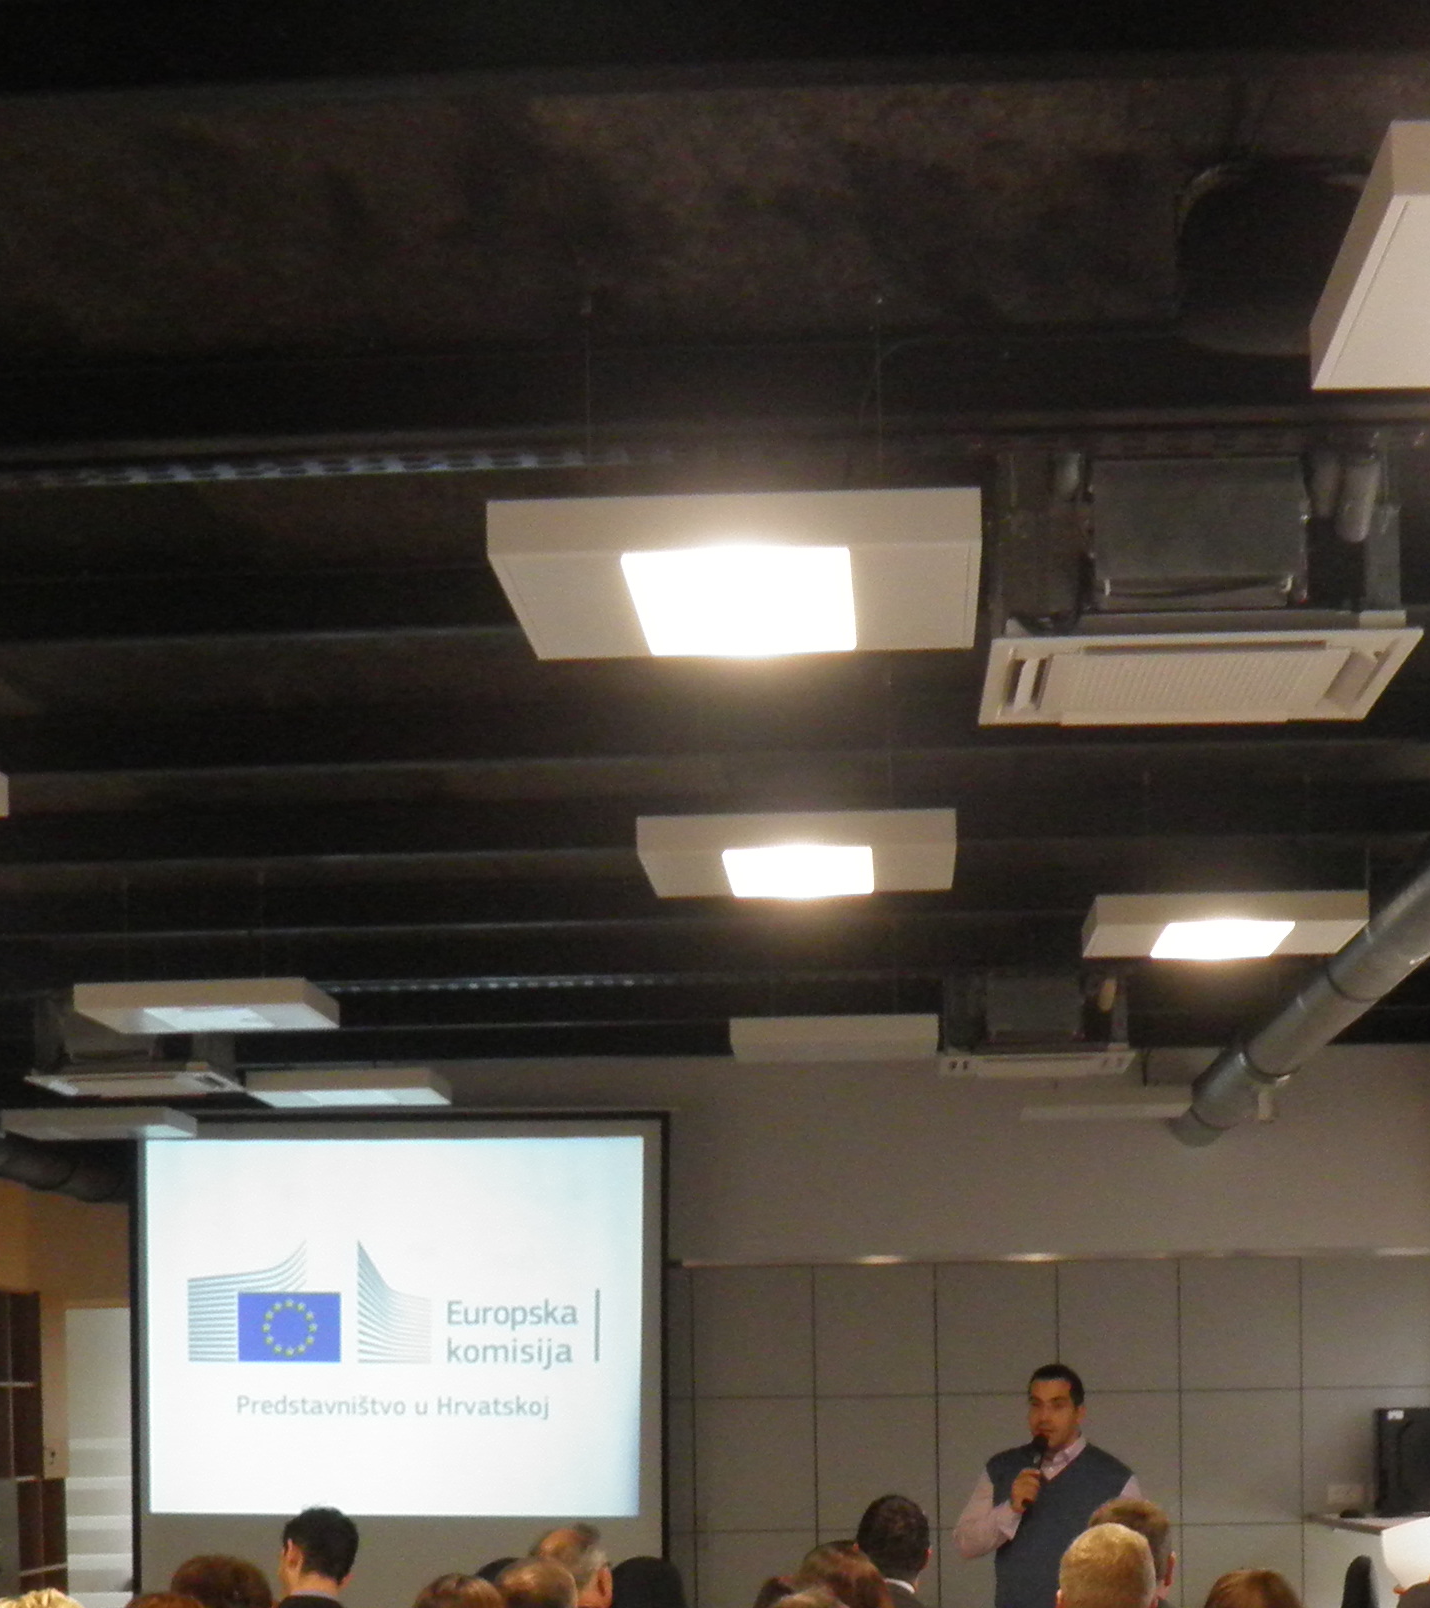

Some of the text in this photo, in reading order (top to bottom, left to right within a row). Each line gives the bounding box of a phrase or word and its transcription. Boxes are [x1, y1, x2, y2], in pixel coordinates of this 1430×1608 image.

[447, 1299, 577, 1331] Europska
[447, 1337, 572, 1370] komisija
[236, 1394, 550, 1420] Predstavništvo u Hrvatskoj
